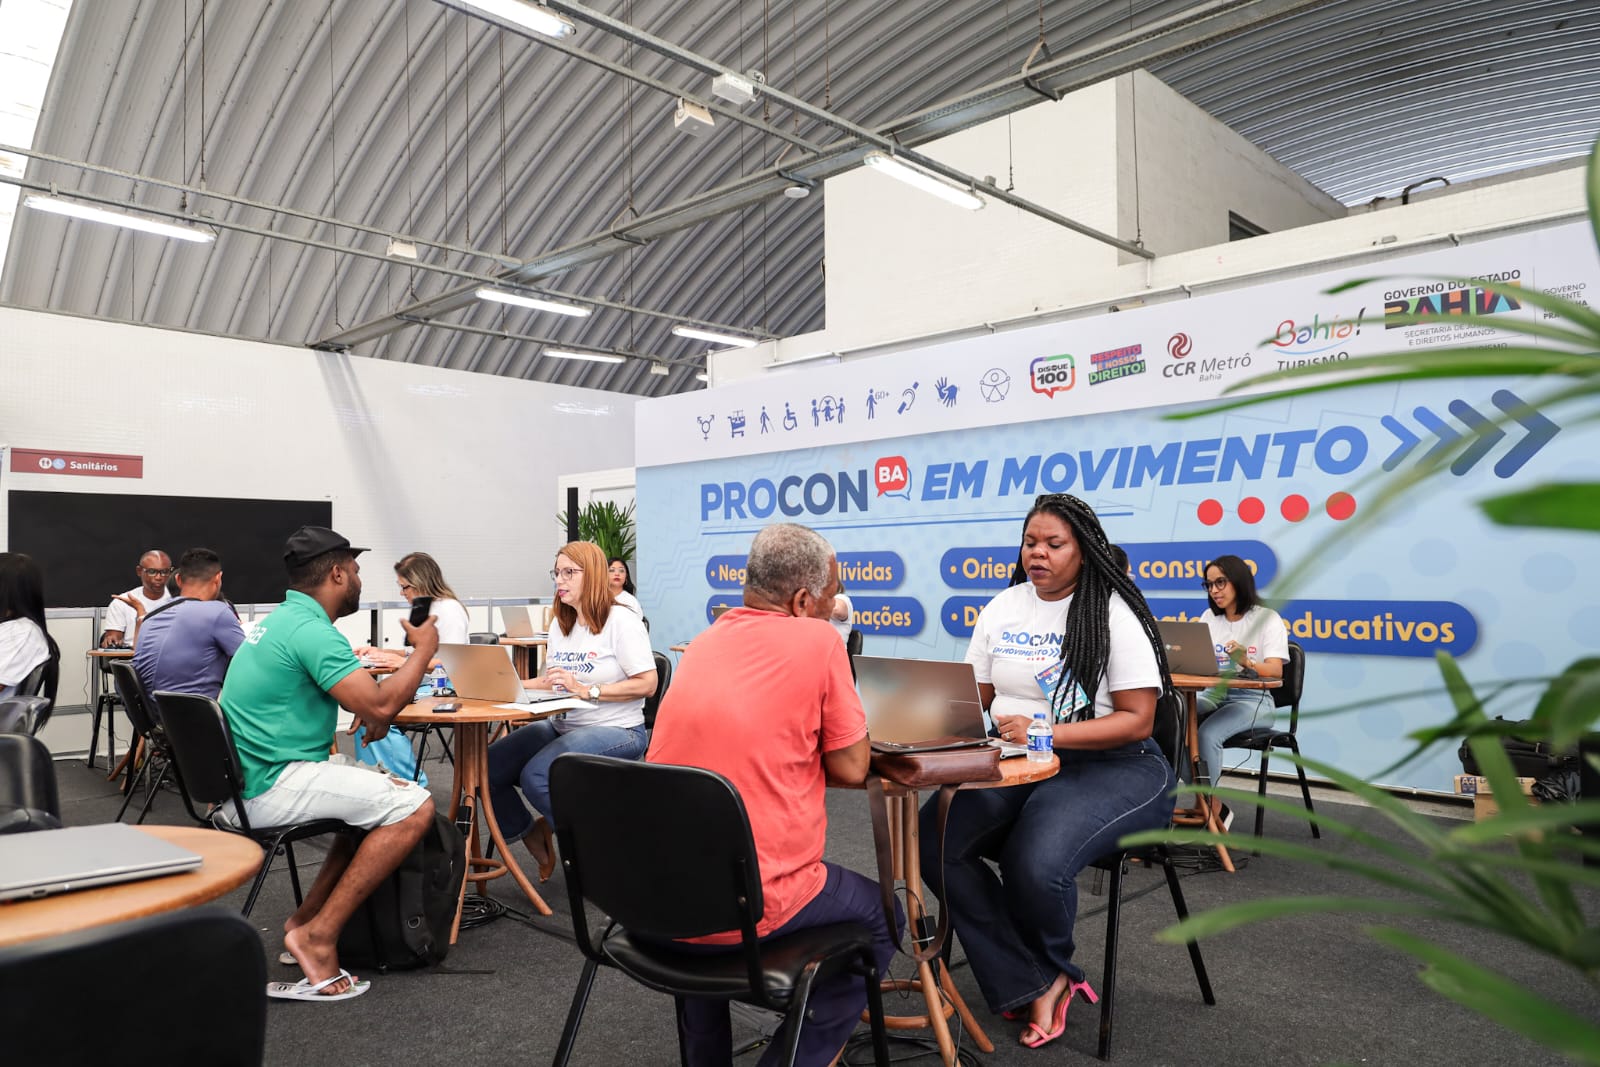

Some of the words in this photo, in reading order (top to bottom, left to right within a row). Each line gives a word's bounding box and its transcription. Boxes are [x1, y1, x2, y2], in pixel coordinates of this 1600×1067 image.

[1384, 283, 1444, 301] GOVERNO
[1448, 281, 1465, 290] DO
[1470, 270, 1520, 287] ESTADO
[1385, 284, 1521, 329] BAHIA
[1404, 325, 1452, 338] SECRETARIA
[1415, 335, 1452, 345] DIREITOS
[1453, 328, 1496, 340] HUMANOS
[1091, 345, 1142, 363] RESPEITO
[1106, 355, 1137, 369] NOSSO
[1037, 363, 1068, 373] DISQUE
[1089, 361, 1146, 384] DIREITO!
[1162, 361, 1196, 378] CCR
[1200, 353, 1252, 374] Metrô
[1037, 371, 1067, 385] 100
[1199, 373, 1222, 382] Bahia
[70, 461, 118, 472] Sanitários
[701, 469, 868, 521] PROCON
[879, 465, 904, 483] BA
[921, 459, 989, 501] EM
[998, 425, 1368, 497] MOVIMENTO
